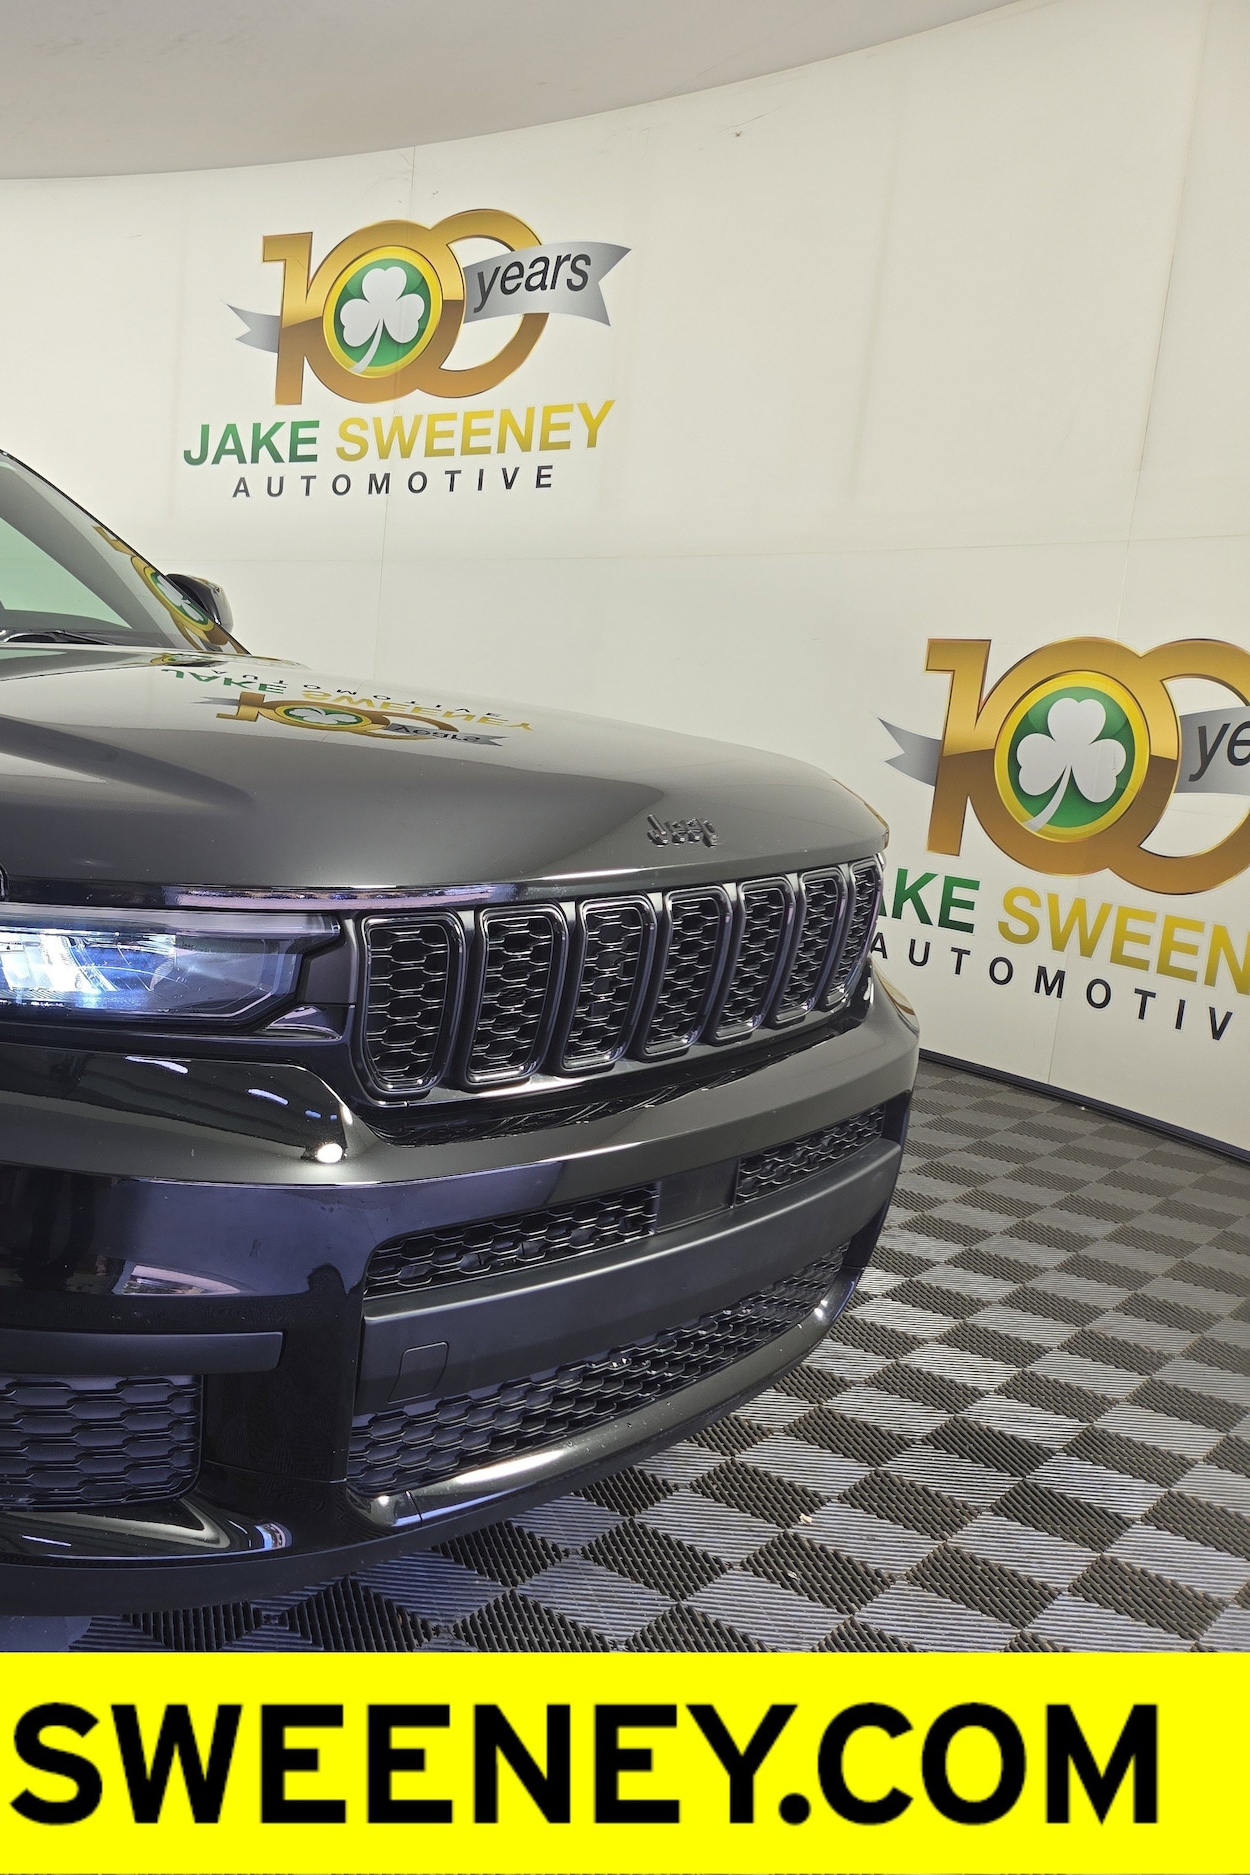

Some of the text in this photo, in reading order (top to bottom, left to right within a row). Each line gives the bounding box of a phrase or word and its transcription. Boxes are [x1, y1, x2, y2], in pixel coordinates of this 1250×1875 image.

[473, 252, 592, 314] years
[183, 399, 616, 466] JAKE SWEENEY
[232, 465, 554, 499] AUTOMOTIVE
[870, 931, 1234, 1041] AUTOMOTIV
